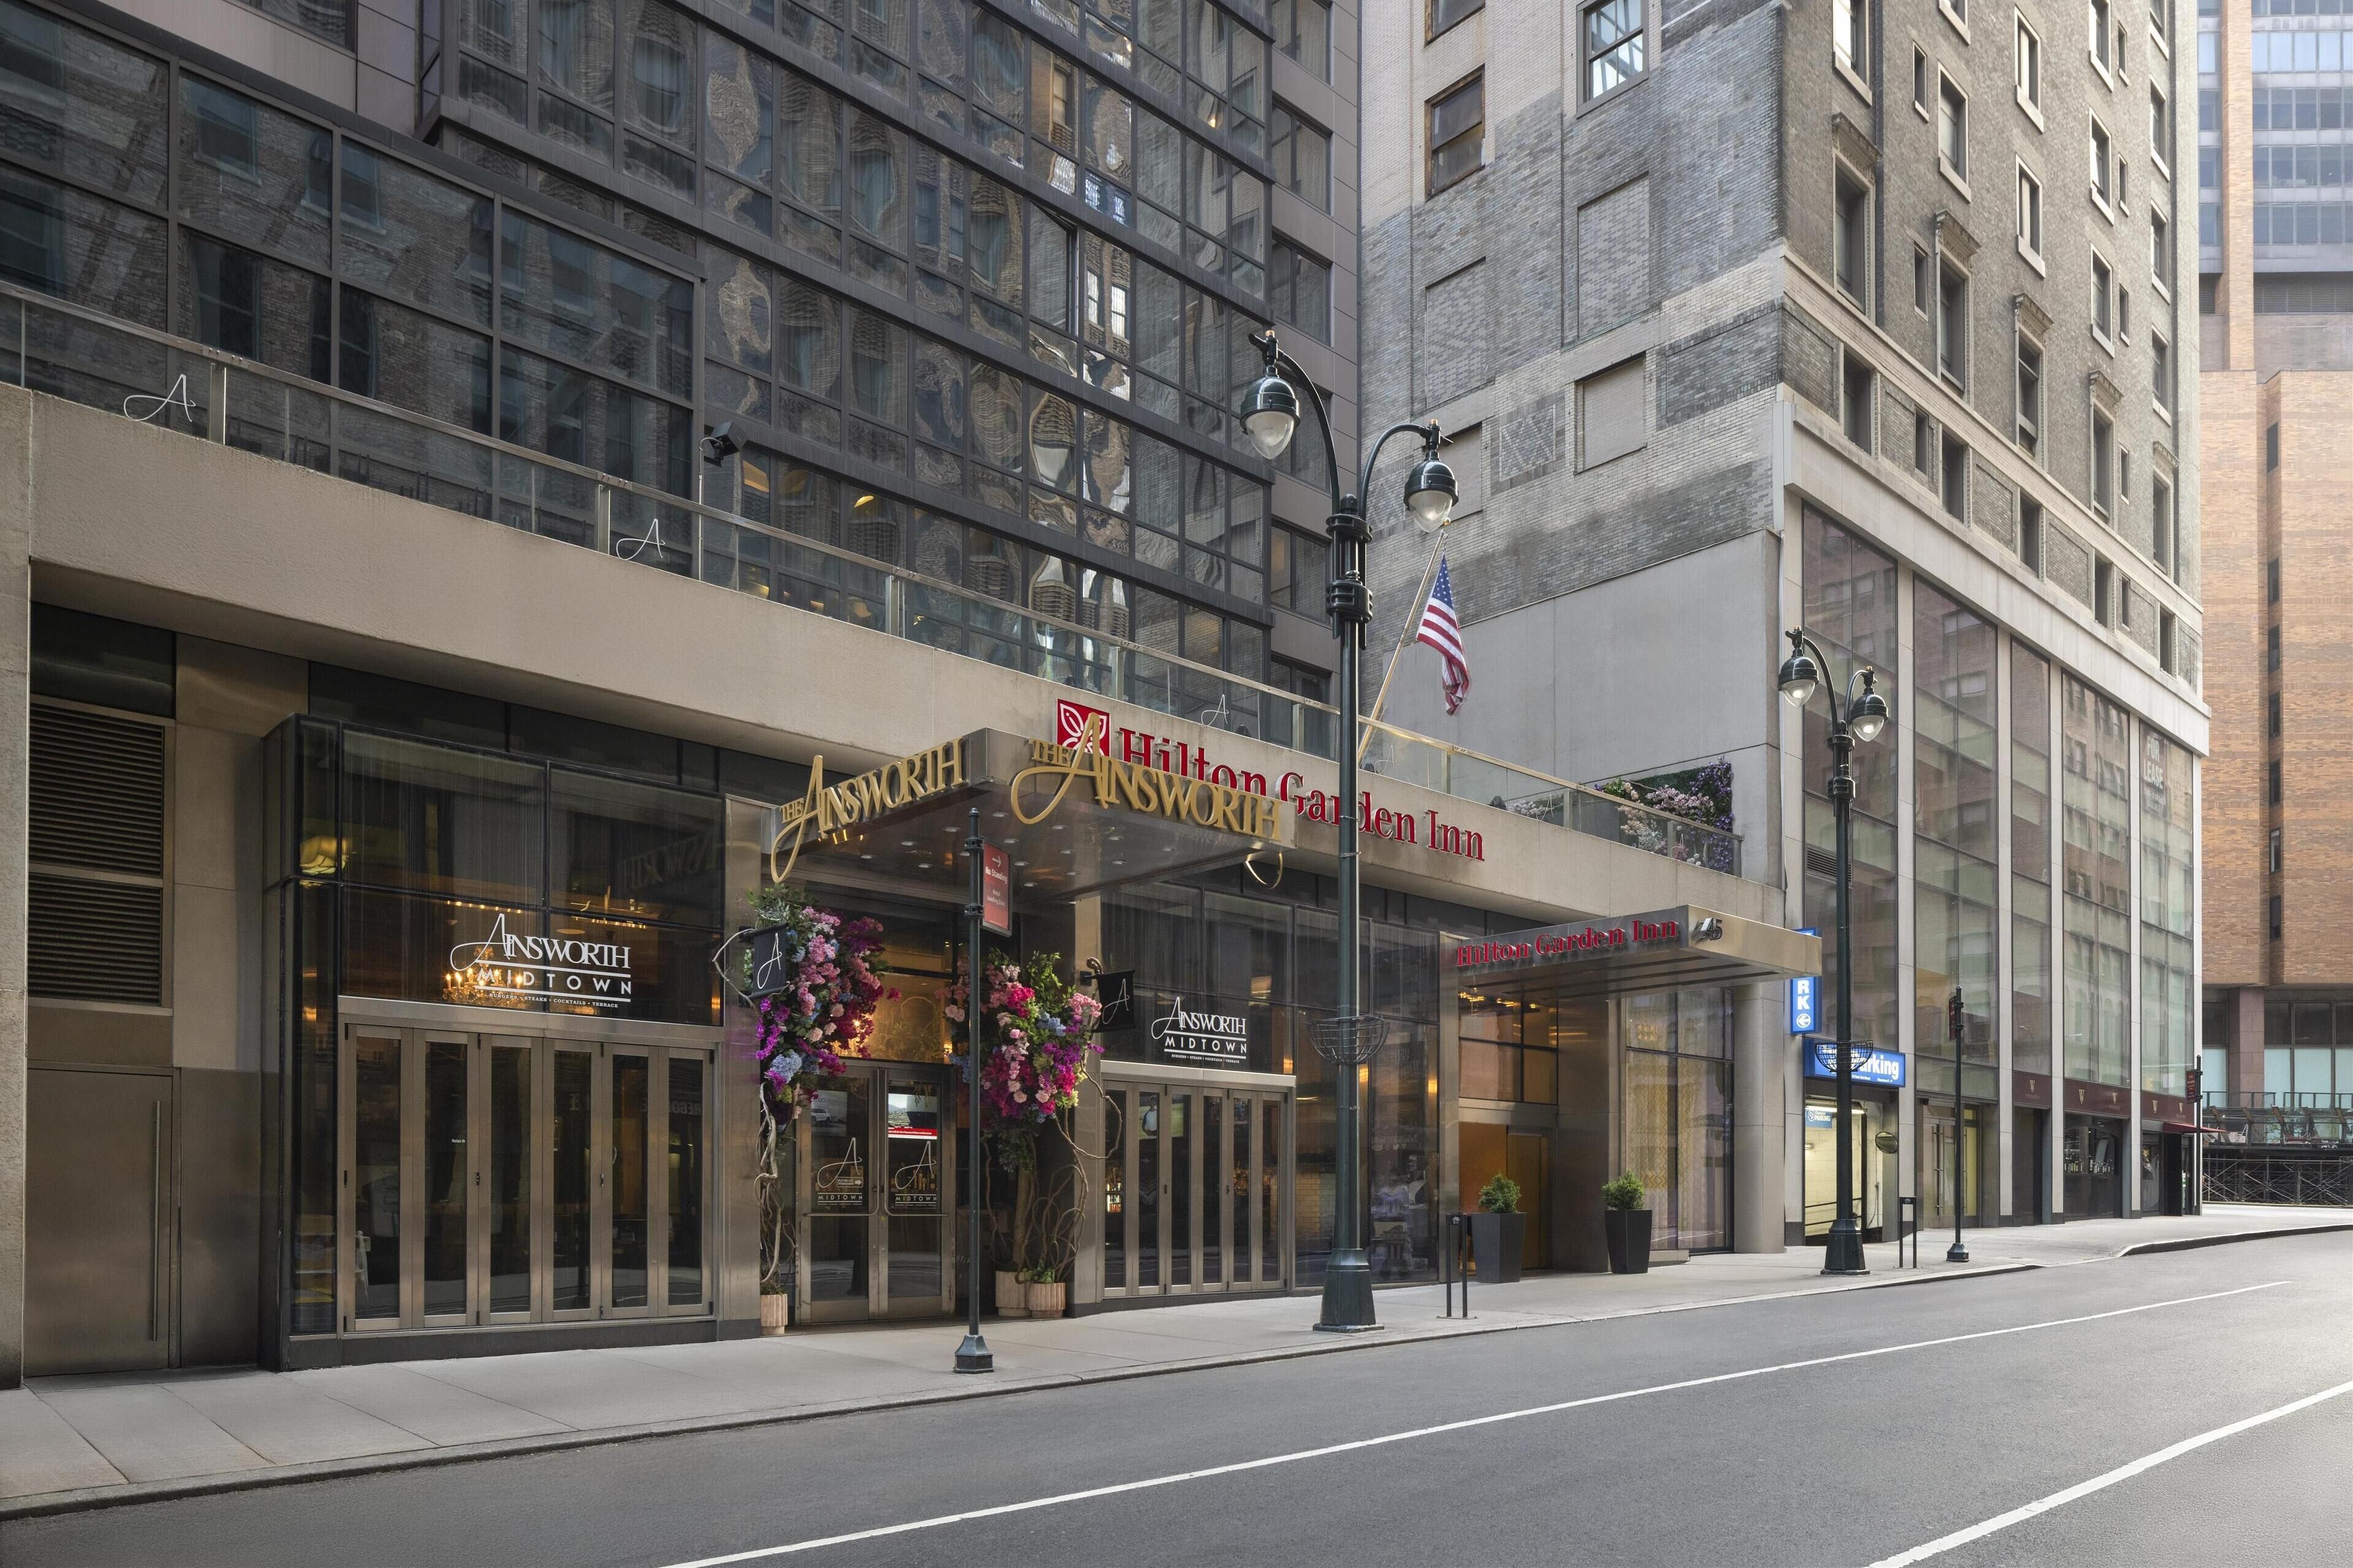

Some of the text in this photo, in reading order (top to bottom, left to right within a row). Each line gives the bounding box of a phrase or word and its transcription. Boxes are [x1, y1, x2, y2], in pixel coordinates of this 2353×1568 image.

[2147, 735, 2160, 762] FOR
[1011, 712, 1282, 842] THE AINSWORTH
[2143, 758, 2164, 790] LEASE
[770, 737, 964, 883] THE AINSWORTH
[1118, 726, 1268, 797] Hilton
[1427, 809, 1486, 862] Inn
[985, 866, 1008, 884] No Standing
[450, 913, 632, 971] AINSWORTH
[1456, 919, 1678, 967] Hilton Garden Inn
[1700, 917, 1723, 941] 45
[476, 967, 632, 995] MIDTOWN
[1151, 996, 1247, 1039] AINSWORTH
[1165, 1035, 1247, 1054] MIDTOWN
